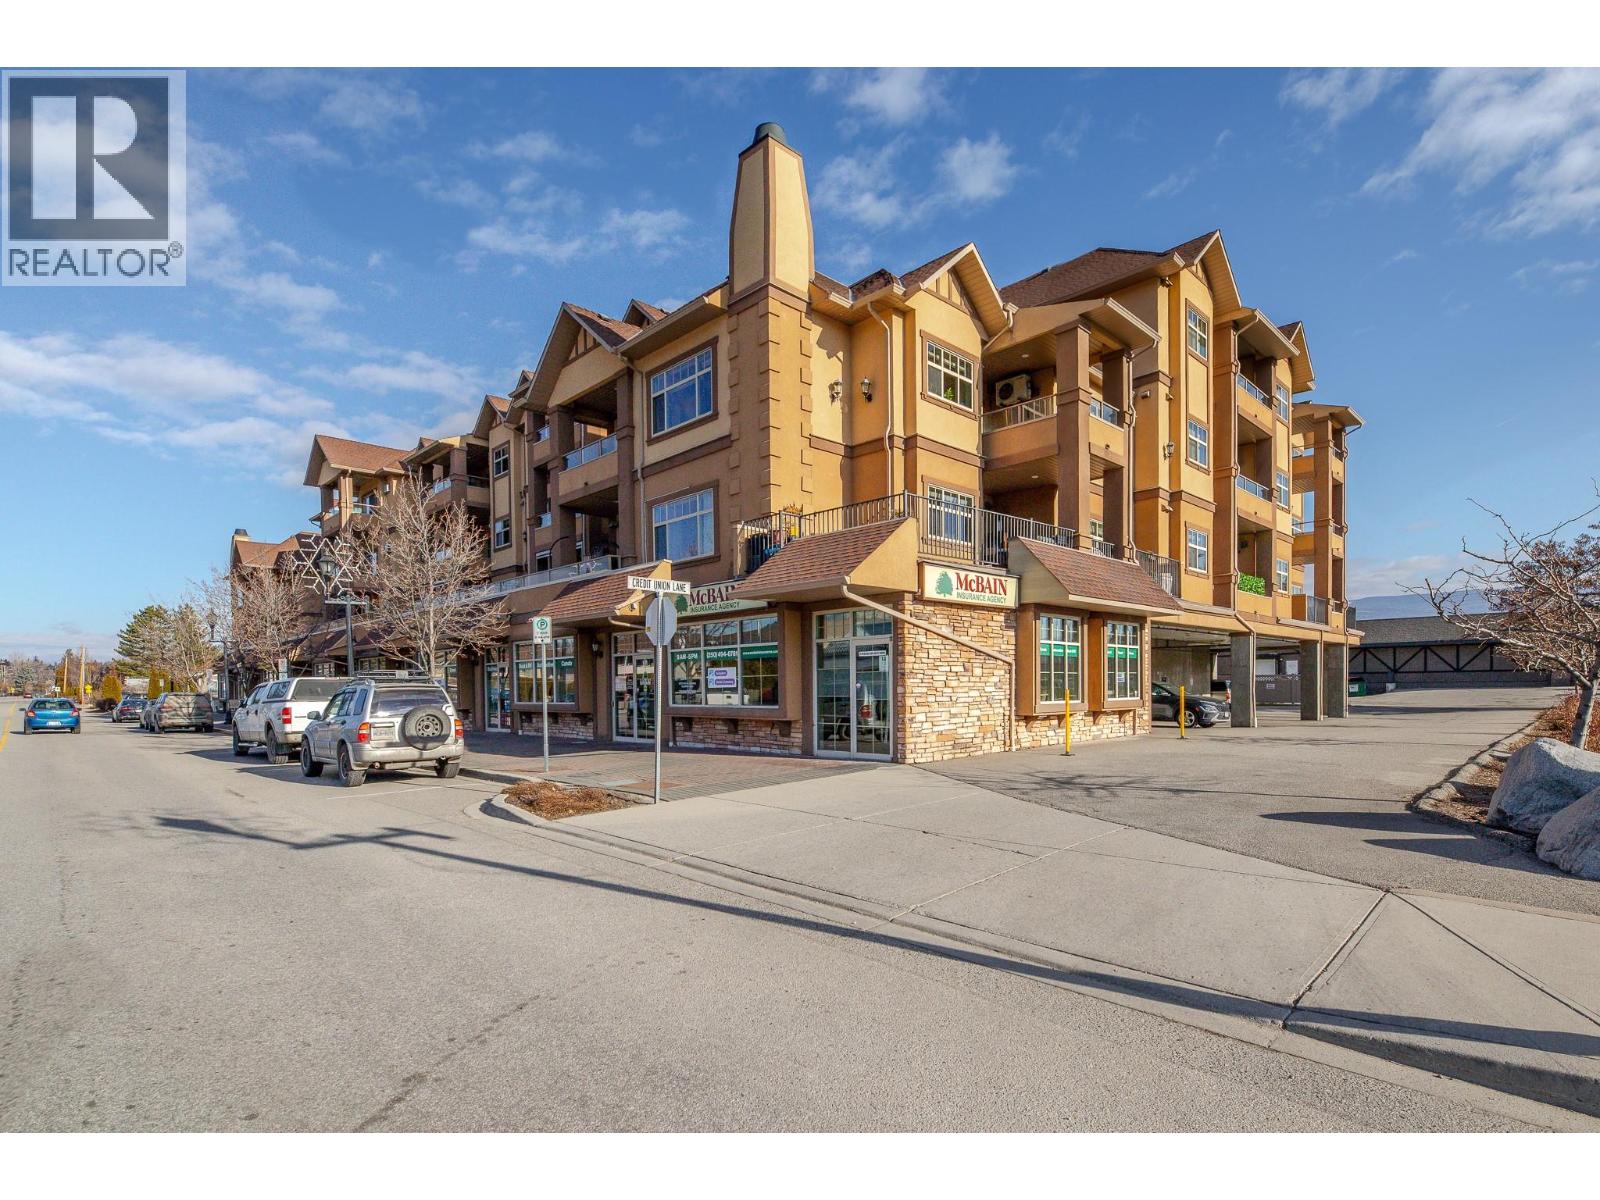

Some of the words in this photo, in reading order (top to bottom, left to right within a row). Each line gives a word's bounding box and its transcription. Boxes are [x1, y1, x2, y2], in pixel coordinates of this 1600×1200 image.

[632, 577, 651, 589] CREDIT
[653, 580, 671, 591] UNION
[672, 582, 687, 593] LANE
[955, 572, 1008, 596] McBAIN
[689, 585, 736, 606] McBAI
[956, 591, 986, 602] INSURANCE
[986, 596, 1007, 604] AGENCY
[690, 604, 718, 613] INSURANCE
[719, 601, 740, 610] AGENCY
